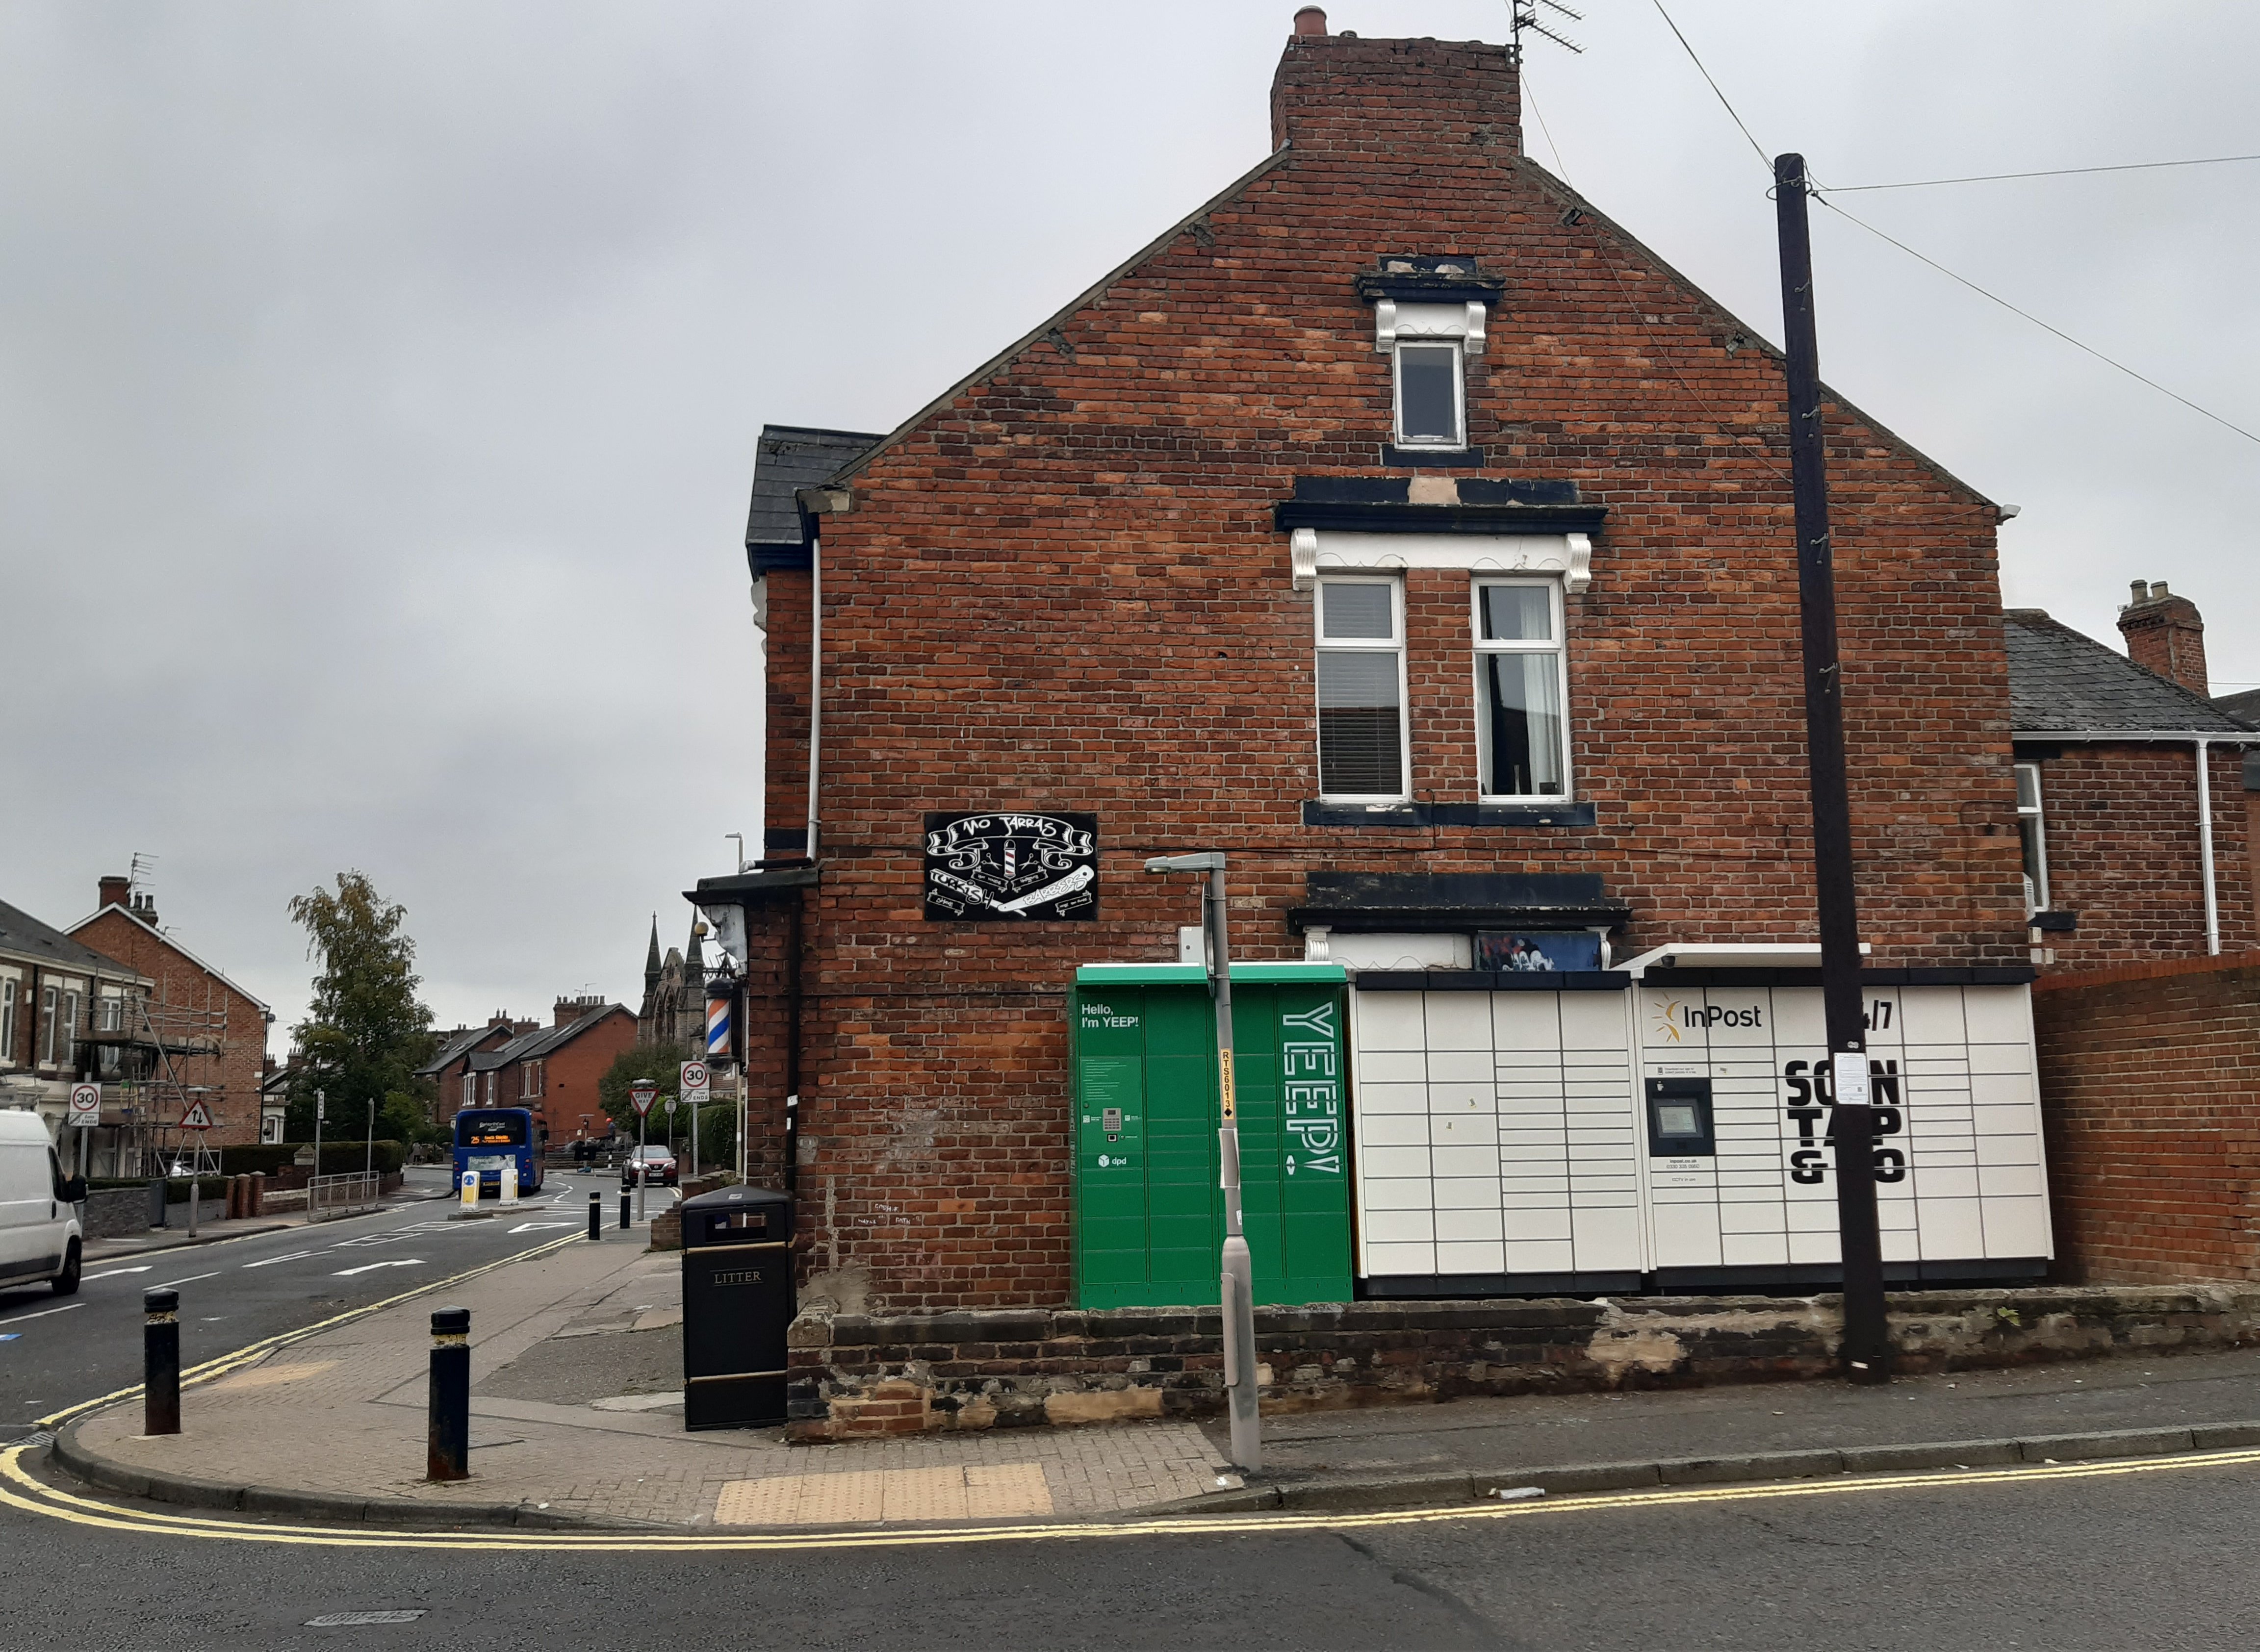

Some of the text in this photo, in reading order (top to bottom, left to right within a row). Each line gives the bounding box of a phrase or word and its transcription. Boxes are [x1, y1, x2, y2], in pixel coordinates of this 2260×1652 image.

[963, 819, 991, 836] MO
[1023, 874, 1088, 905] BARBERS
[1081, 1004, 1114, 1016] Hello,
[1081, 1016, 1139, 1028] I'm YEEP!
[1684, 1005, 1762, 1028] InPost
[687, 1069, 703, 1080] 30
[1283, 1001, 1340, 1175] YEEP!
[77, 1092, 94, 1103] 30
[470, 1136, 480, 1144] 25
[1111, 1156, 1127, 1167] dpd
[714, 1271, 762, 1284] LITTER
